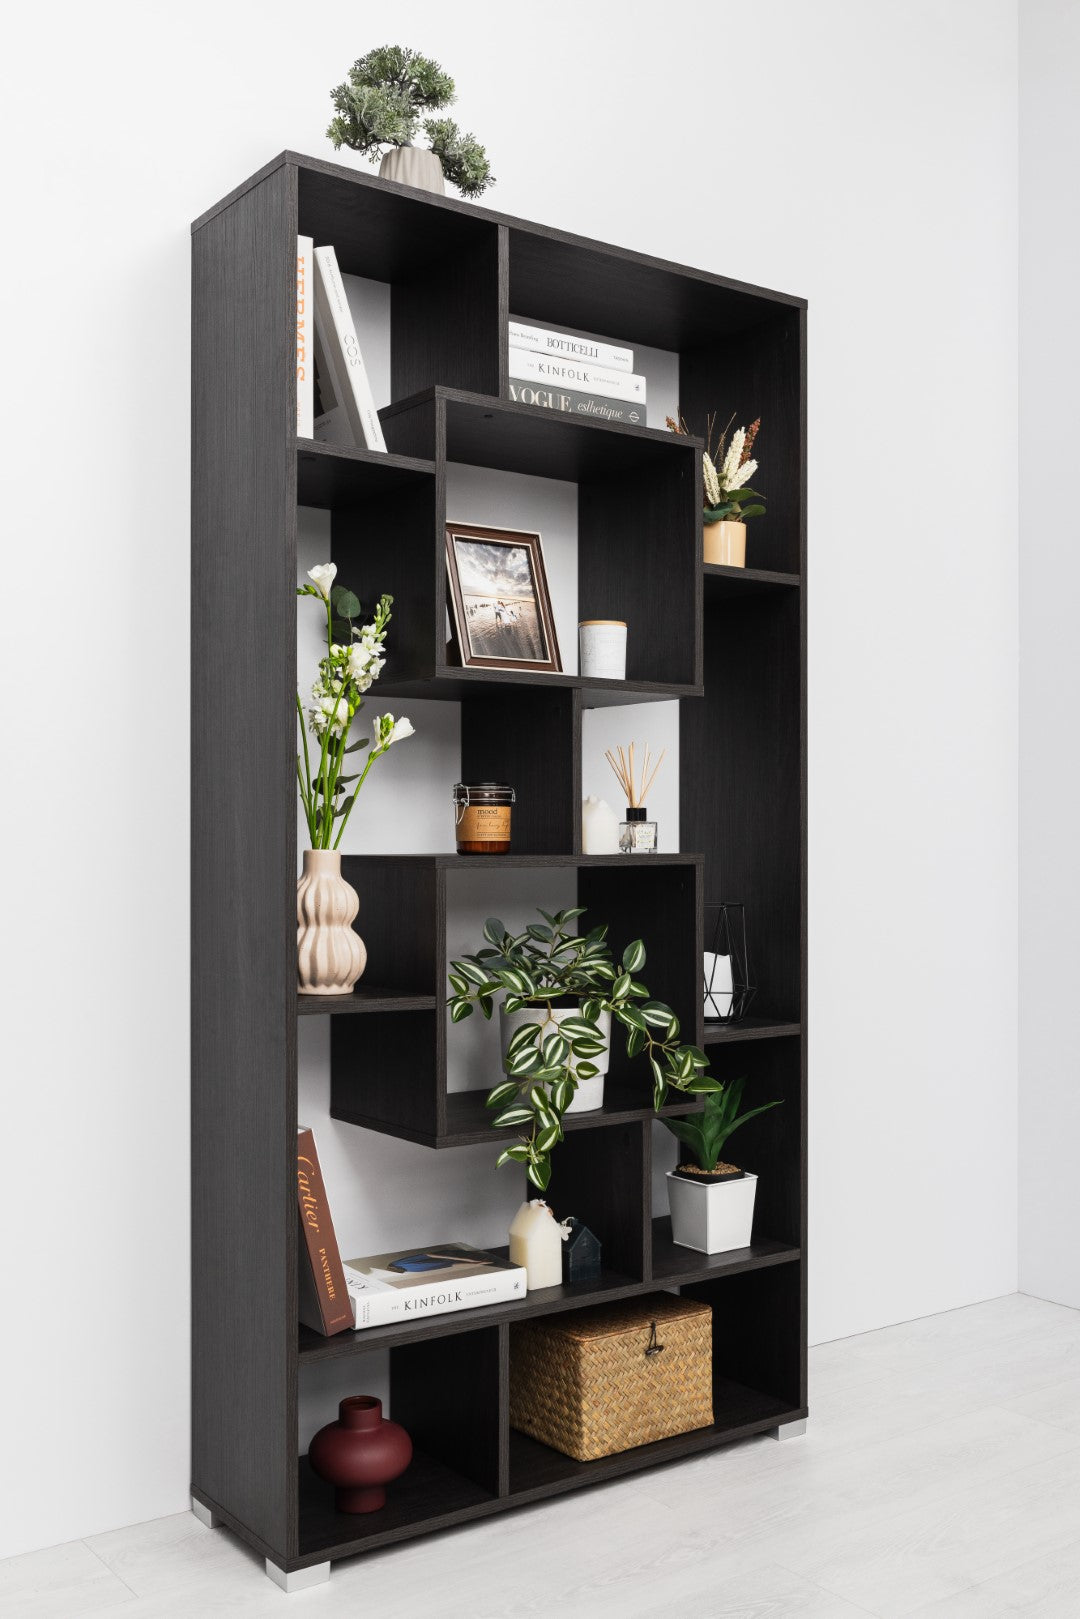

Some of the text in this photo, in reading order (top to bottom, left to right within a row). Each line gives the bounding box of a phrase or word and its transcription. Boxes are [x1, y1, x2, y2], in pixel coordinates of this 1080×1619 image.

[344, 335, 361, 367] COS
[546, 337, 598, 358] BOTTICELLI
[538, 363, 590, 382] KINFOLK
[509, 384, 572, 413] VOGUE
[404, 1291, 462, 1311] KINFOLK
